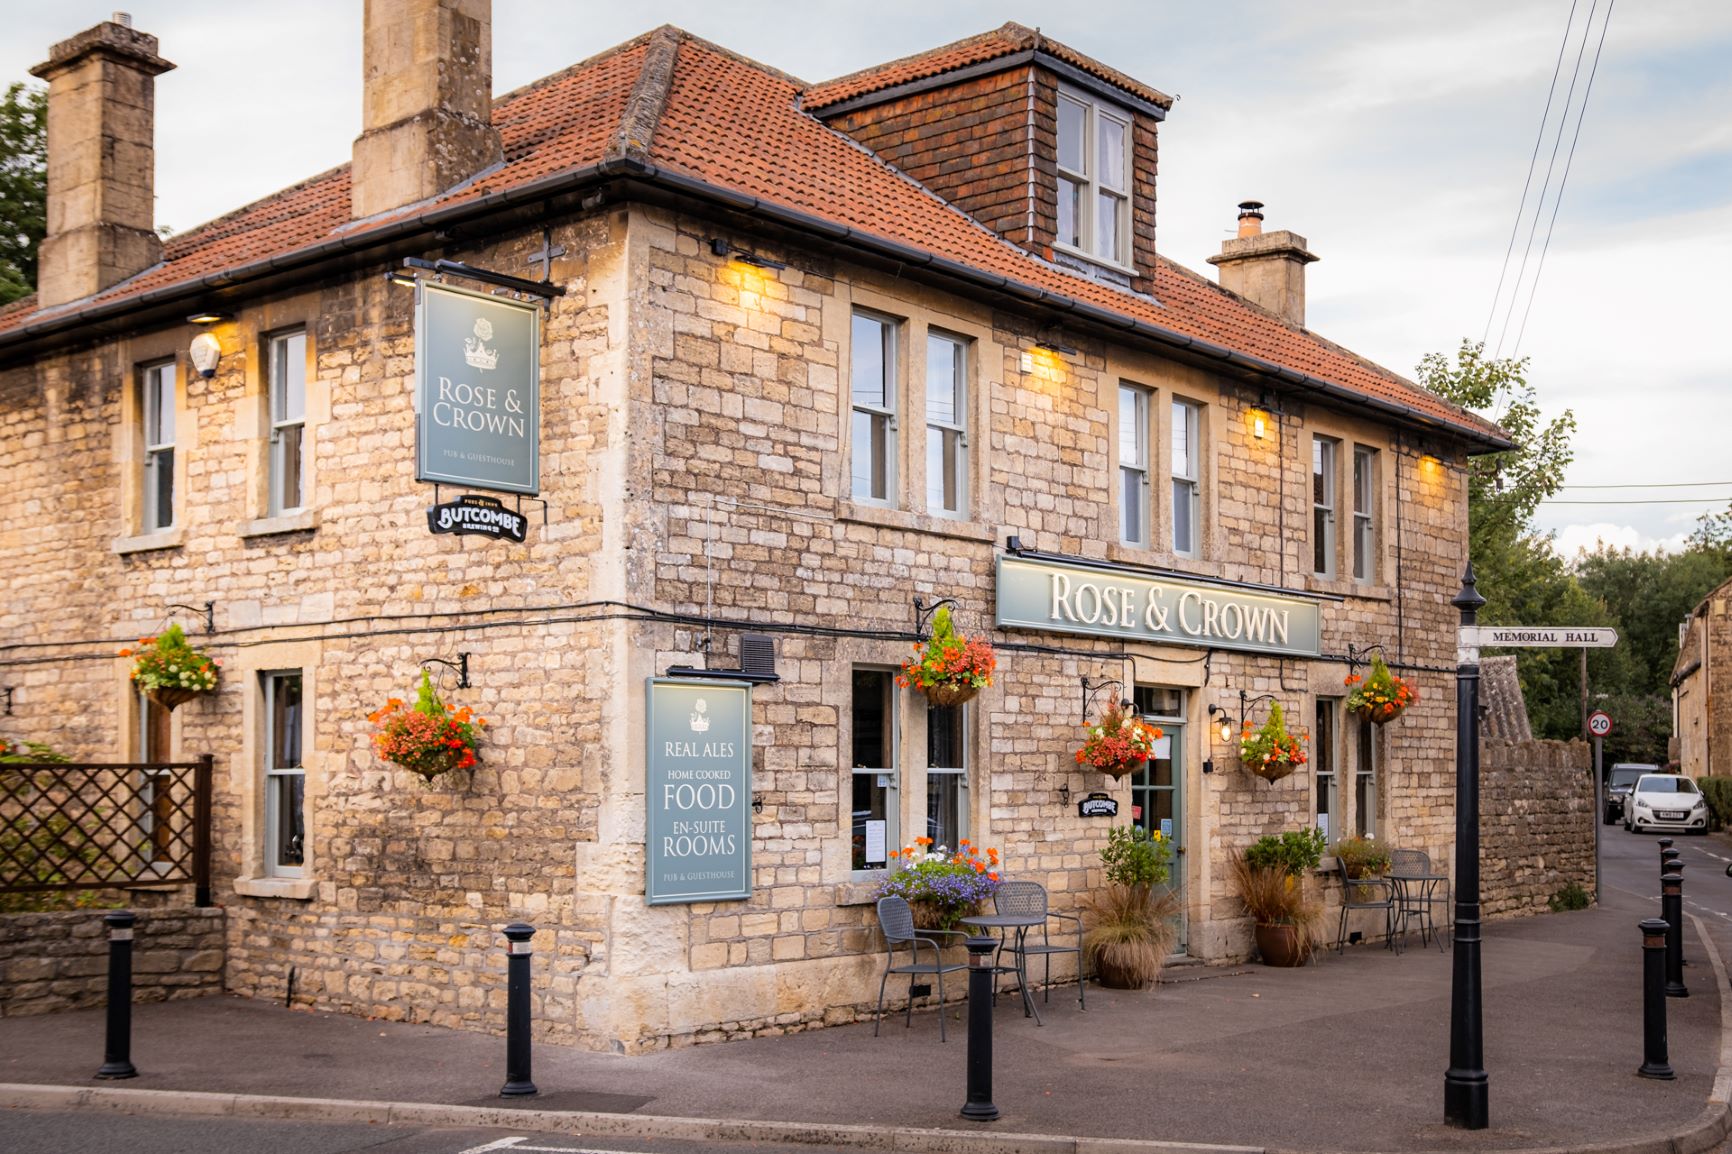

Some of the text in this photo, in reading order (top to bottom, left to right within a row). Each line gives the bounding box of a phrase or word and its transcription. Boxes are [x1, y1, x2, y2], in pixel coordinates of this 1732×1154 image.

[438, 376, 524, 414] ROSE &
[433, 402, 525, 438] CROWN
[443, 449, 515, 467] PUB & GUESTHOUSE
[437, 506, 521, 538] BUTCOMBE
[462, 523, 492, 532] BREWING
[1050, 572, 1289, 645] ROSE & CROWN
[1493, 632, 1598, 642] MEMORIAL HALL
[1592, 719, 1609, 730] 20
[665, 741, 734, 758] REAL ALES
[667, 770, 731, 780] HOME COOKED
[663, 784, 735, 810] FOOD
[673, 820, 726, 835] EN-SUITE
[663, 834, 735, 857] ROOMS
[664, 870, 735, 882] PUB & GUESTHOUSE
